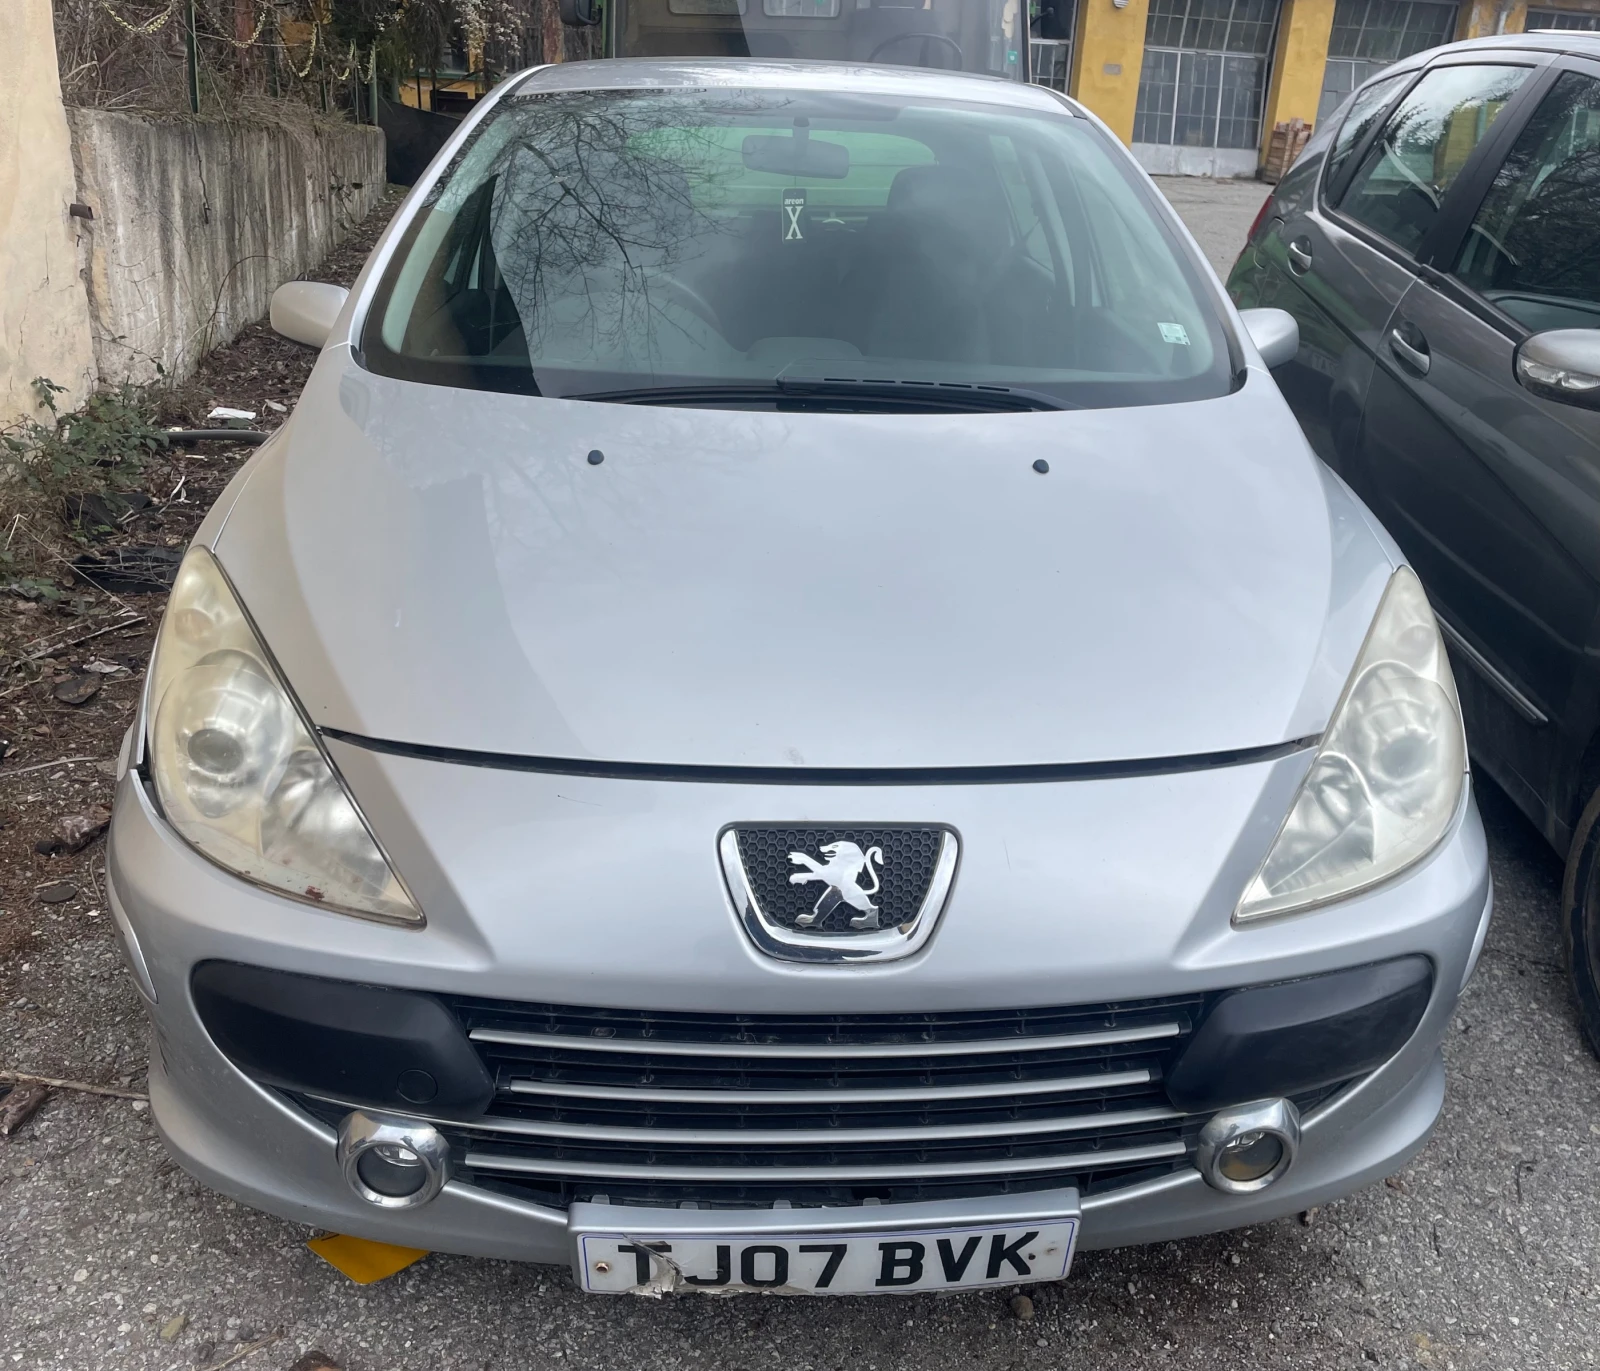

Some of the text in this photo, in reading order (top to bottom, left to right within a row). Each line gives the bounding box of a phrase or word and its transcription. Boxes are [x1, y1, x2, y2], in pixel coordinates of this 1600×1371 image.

[784, 206, 804, 240] X
[617, 1230, 1040, 1289] TJ07 BVK
